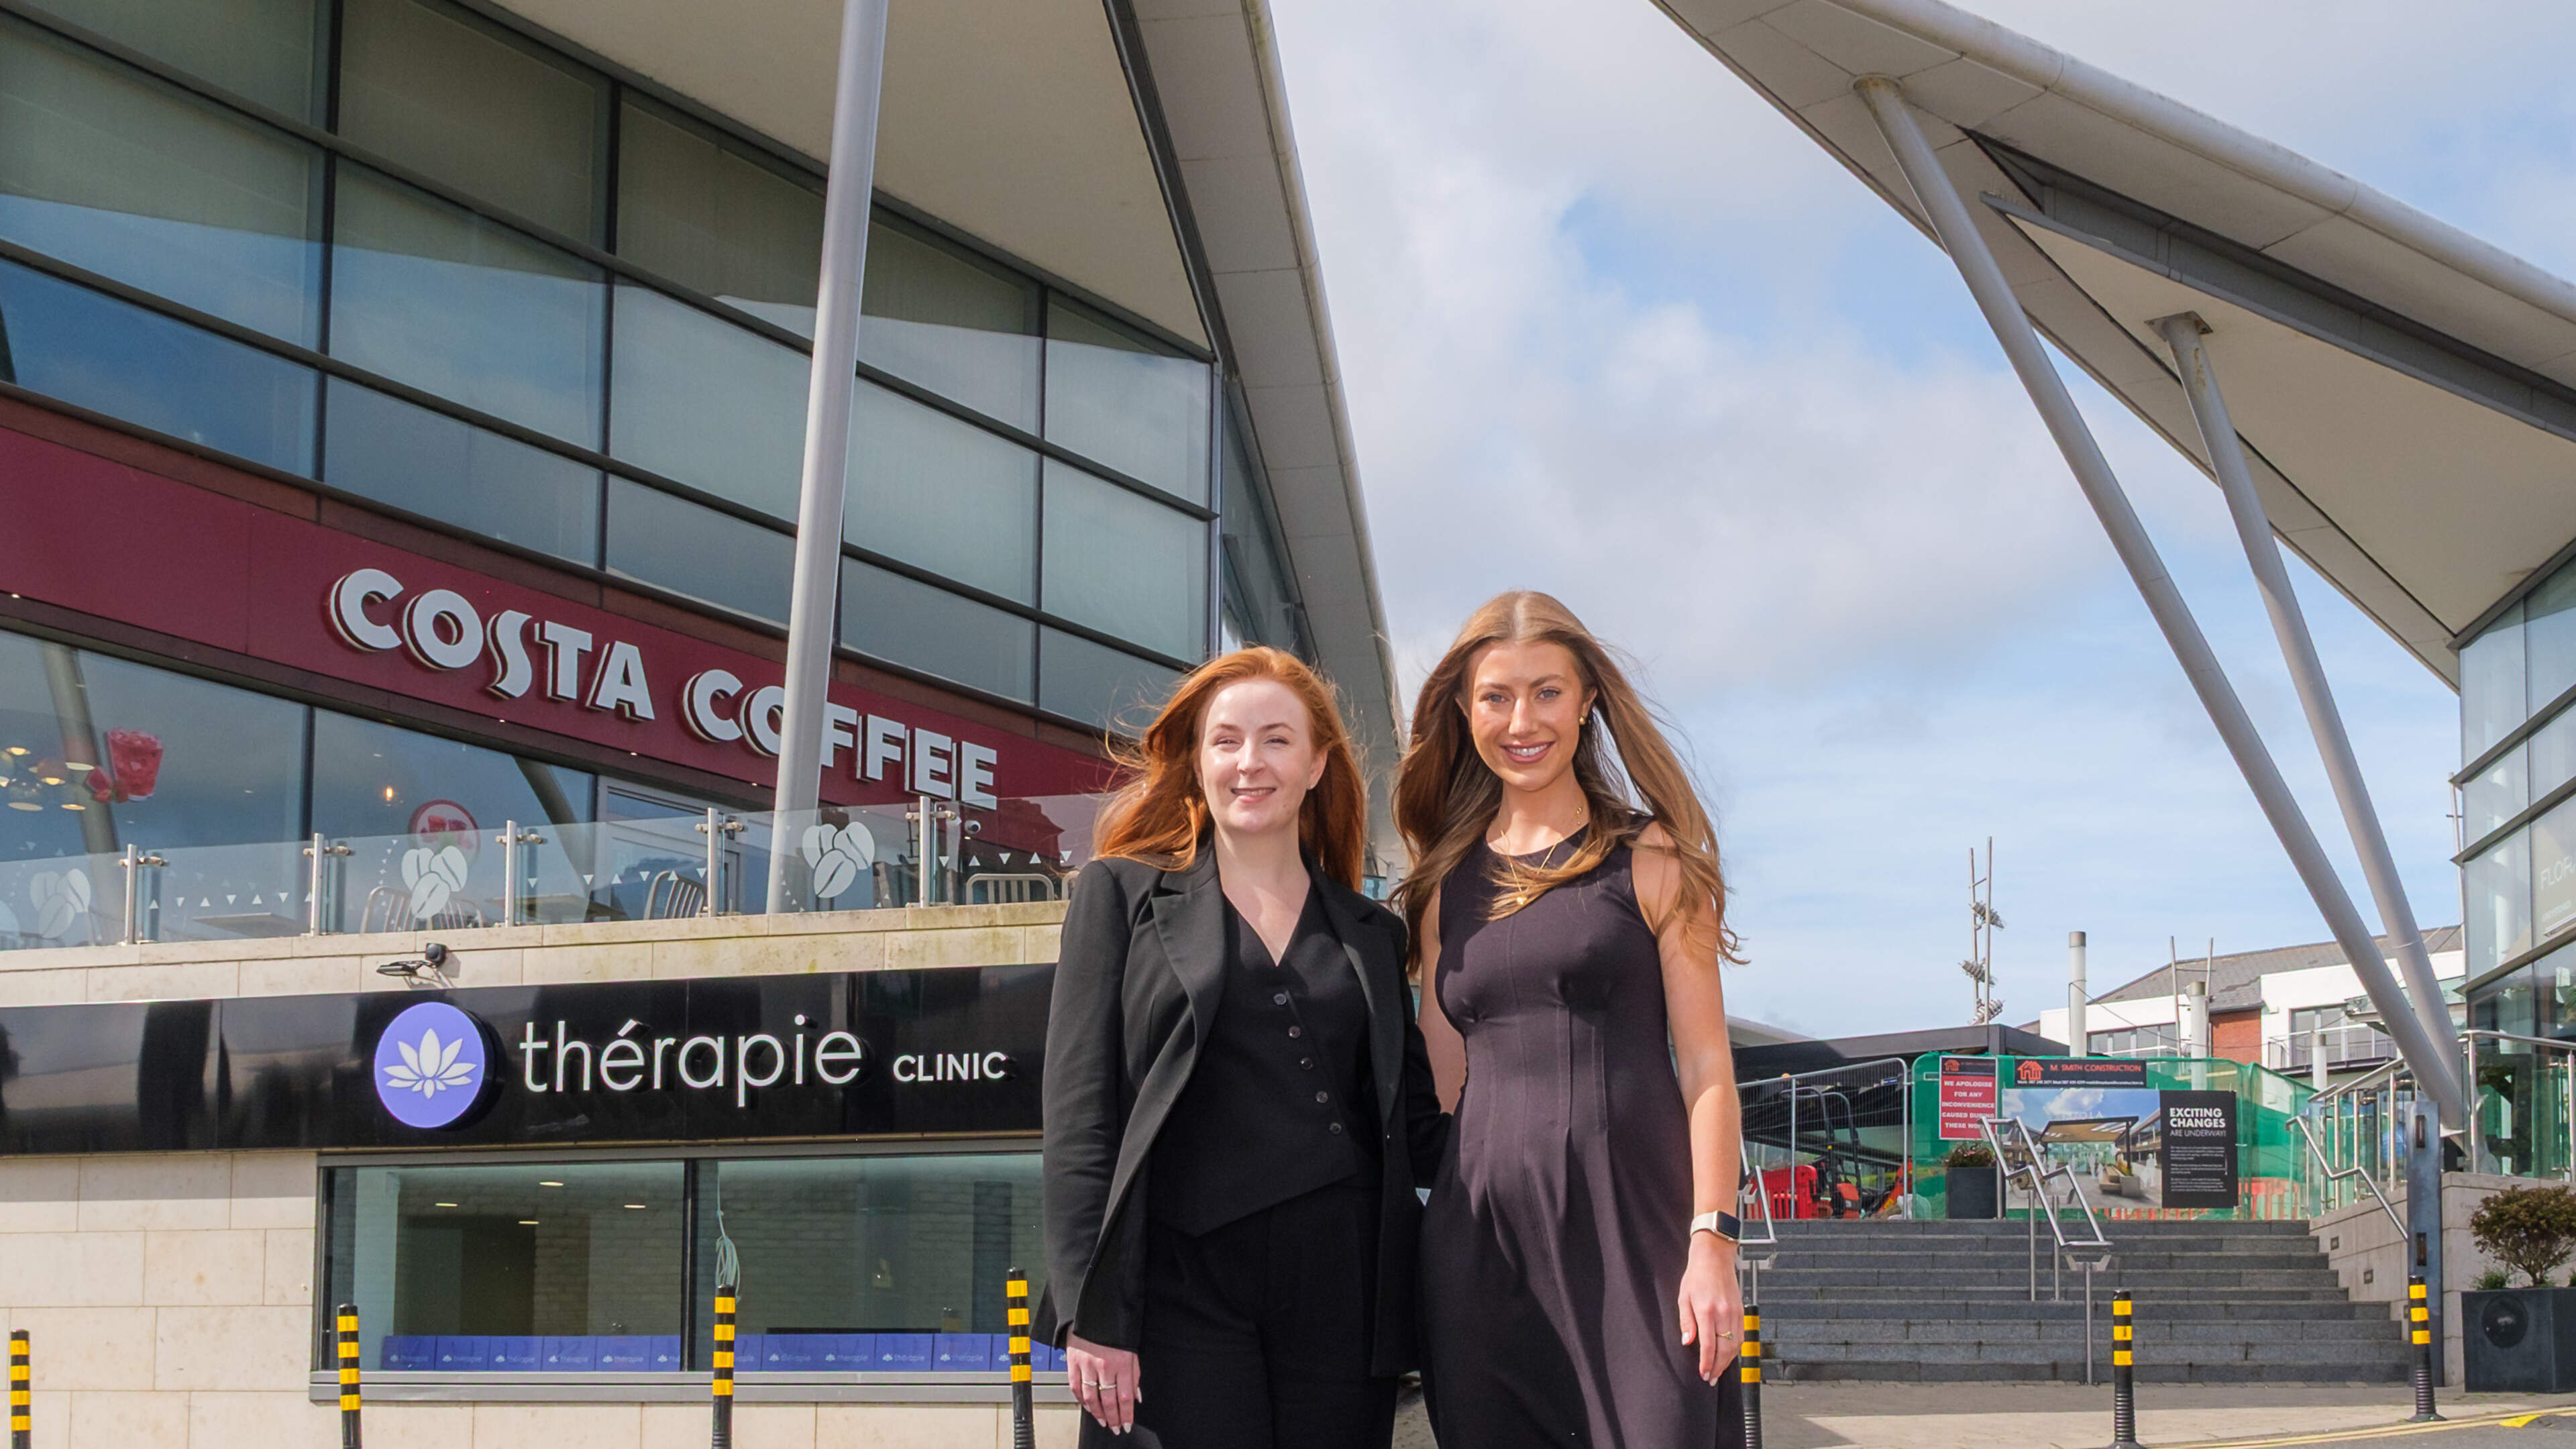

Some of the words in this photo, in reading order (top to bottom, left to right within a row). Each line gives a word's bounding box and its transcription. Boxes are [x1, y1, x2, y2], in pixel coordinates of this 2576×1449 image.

[331, 569, 655, 722] COSTA
[683, 669, 998, 810] COFFEE
[519, 1014, 863, 1108] thérapie
[892, 1051, 1007, 1082] CLINIC
[2061, 1064, 2083, 1072] SMITH
[2084, 1064, 2142, 1072] CONSTRUCTION
[2169, 1108, 2222, 1118] EXCITING
[2169, 1118, 2226, 1128] CHANGES
